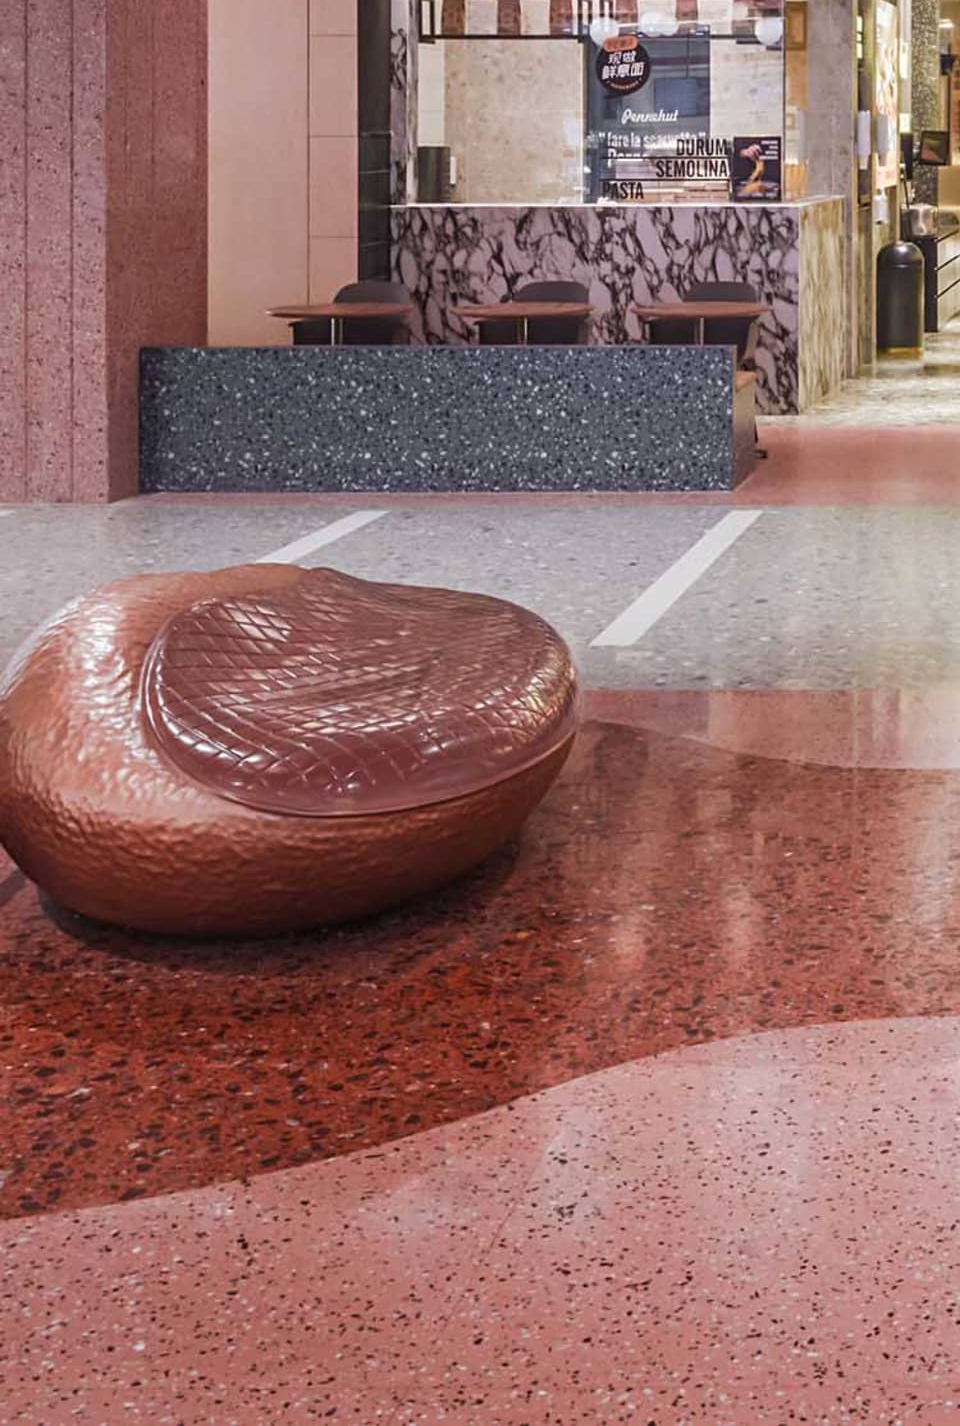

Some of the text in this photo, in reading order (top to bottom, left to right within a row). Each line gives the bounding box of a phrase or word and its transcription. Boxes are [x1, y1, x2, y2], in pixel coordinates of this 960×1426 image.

[621, 108, 679, 124] Pennehut
[676, 138, 728, 156] DURUM
[655, 160, 728, 178] SEMOLINA
[602, 181, 644, 199] PASTA
